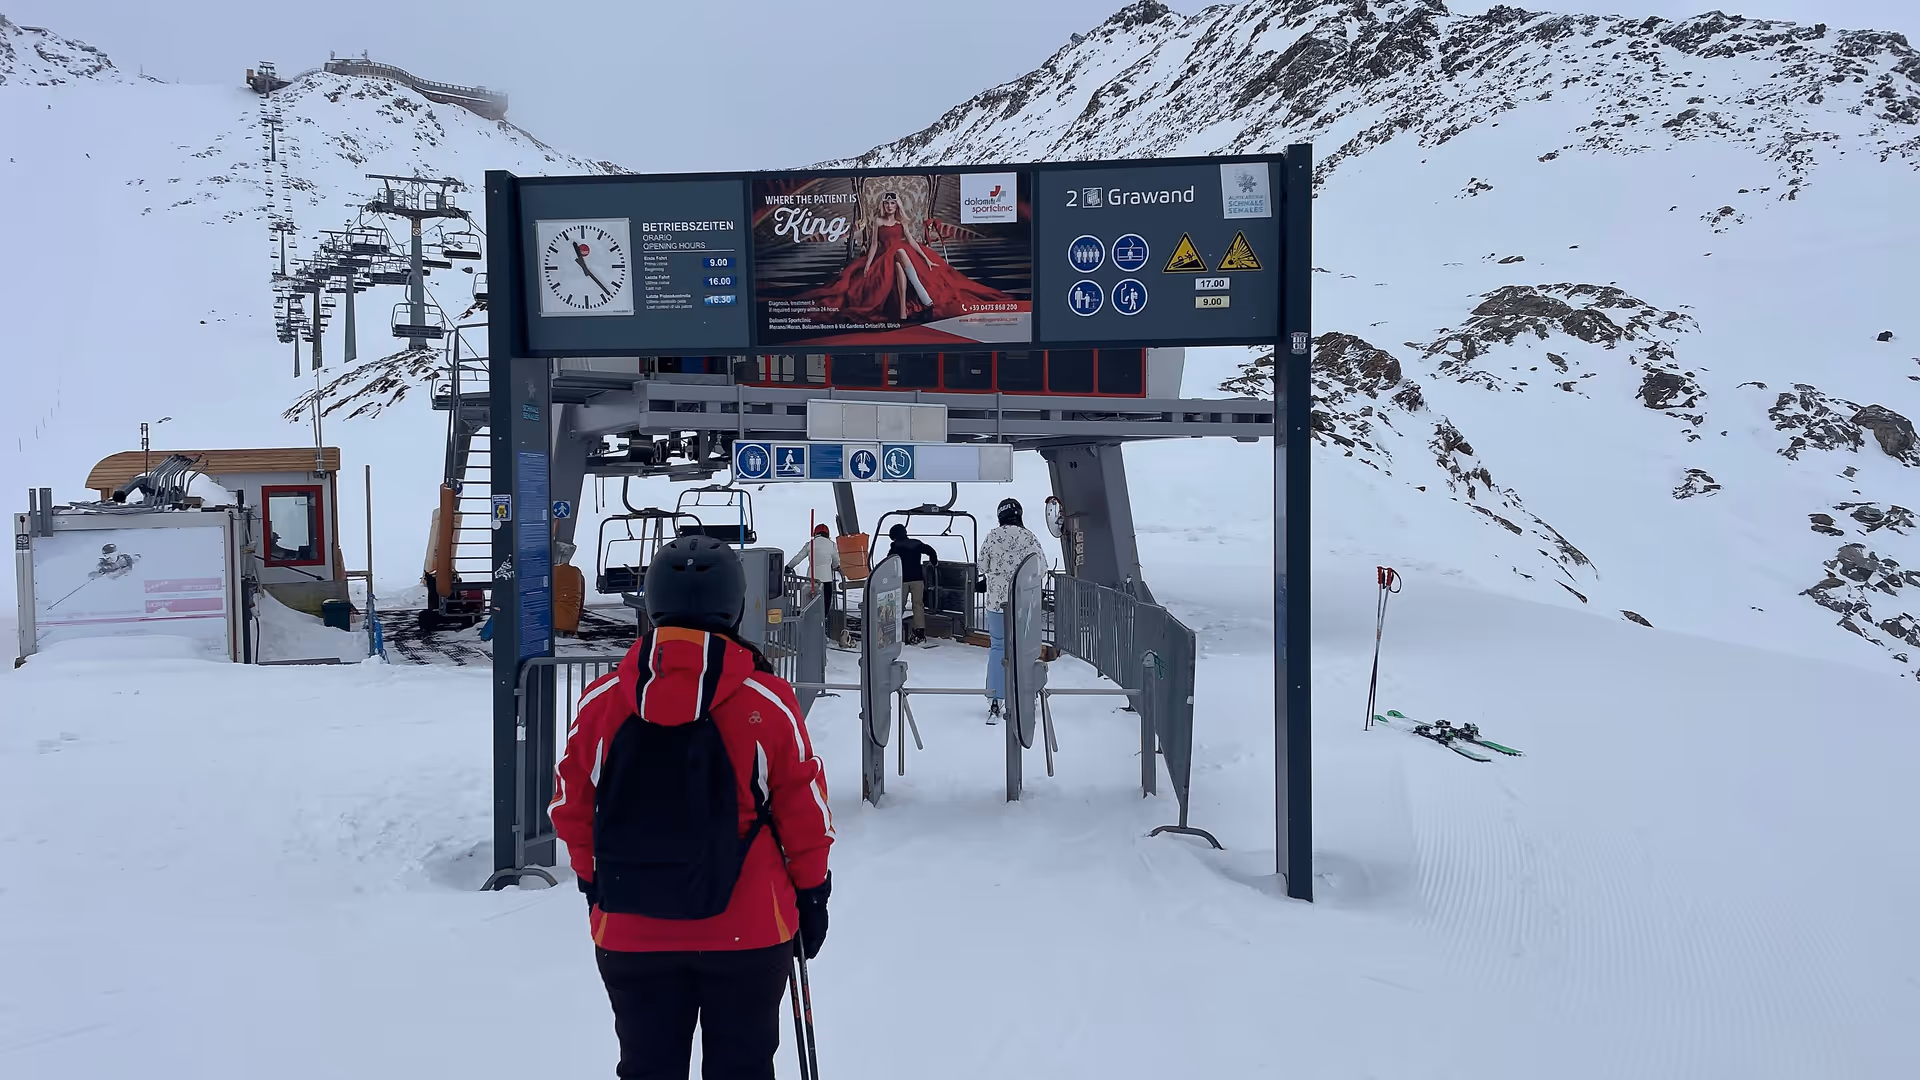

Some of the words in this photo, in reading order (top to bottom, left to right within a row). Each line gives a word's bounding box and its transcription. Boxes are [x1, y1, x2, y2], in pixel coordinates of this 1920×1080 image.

[765, 195, 794, 205] WHERE
[796, 195, 813, 204] THE
[814, 193, 847, 204] PATIENT
[849, 193, 857, 203] IS
[1066, 190, 1078, 207] 2
[1108, 185, 1194, 206] Grawand
[964, 197, 996, 206] dolomiti
[972, 204, 1013, 214] sportclinic
[642, 220, 735, 232] BETRIEBSZEITEN
[774, 207, 851, 243] King
[642, 233, 673, 241] ORARIO
[643, 242, 677, 250] OPENING
[678, 241, 706, 249] HOURS
[709, 258, 728, 267] 9.00
[708, 277, 731, 286] 16.00
[1200, 279, 1225, 288] 17.00
[710, 295, 732, 304] 16.30
[1202, 298, 1222, 306] 9.00
